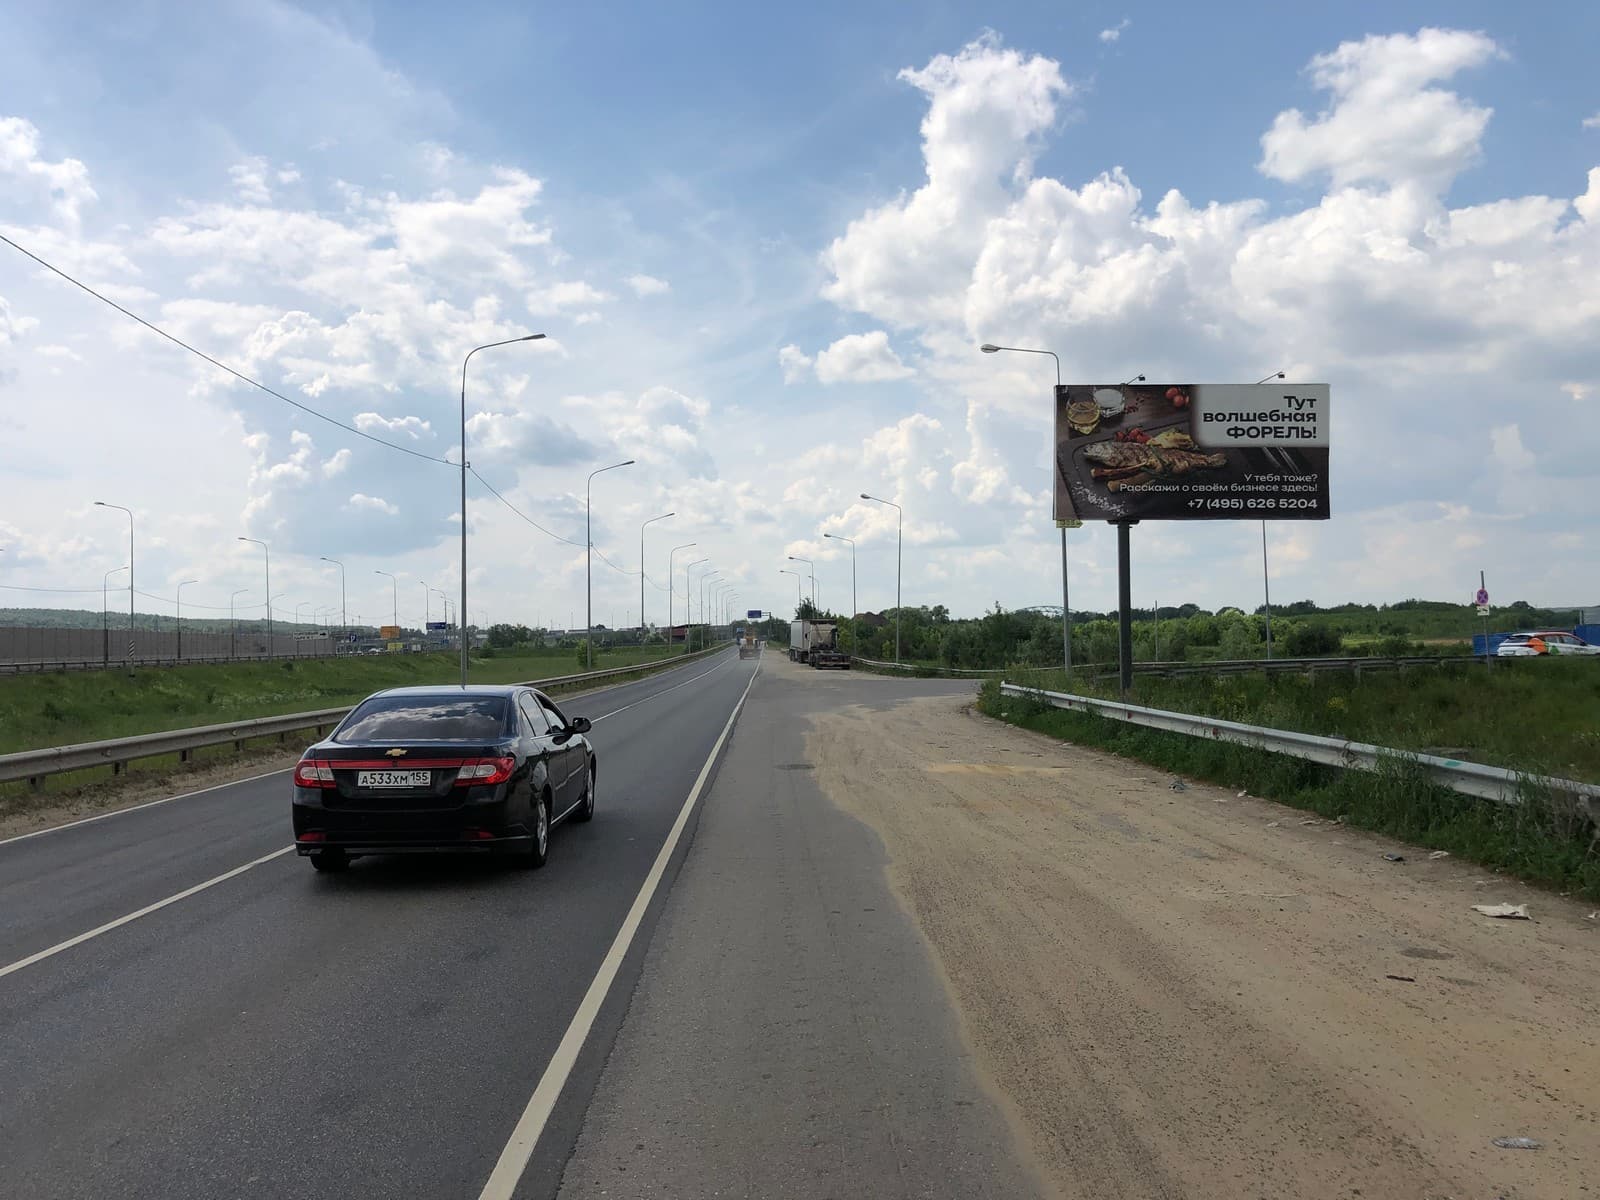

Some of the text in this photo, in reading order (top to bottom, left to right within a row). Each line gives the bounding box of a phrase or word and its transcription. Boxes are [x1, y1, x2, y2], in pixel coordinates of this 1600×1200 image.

[1283, 395, 1317, 410] Тут
[1203, 409, 1317, 422] волшебная
[1226, 426, 1317, 439] ФОРЕЛЬ!
[1244, 473, 1318, 482] У тебя тоже?
[1120, 482, 1318, 493] Расскажи о своём бизнесе здесь!
[1187, 498, 1318, 510] +7 (495) 626 5204
